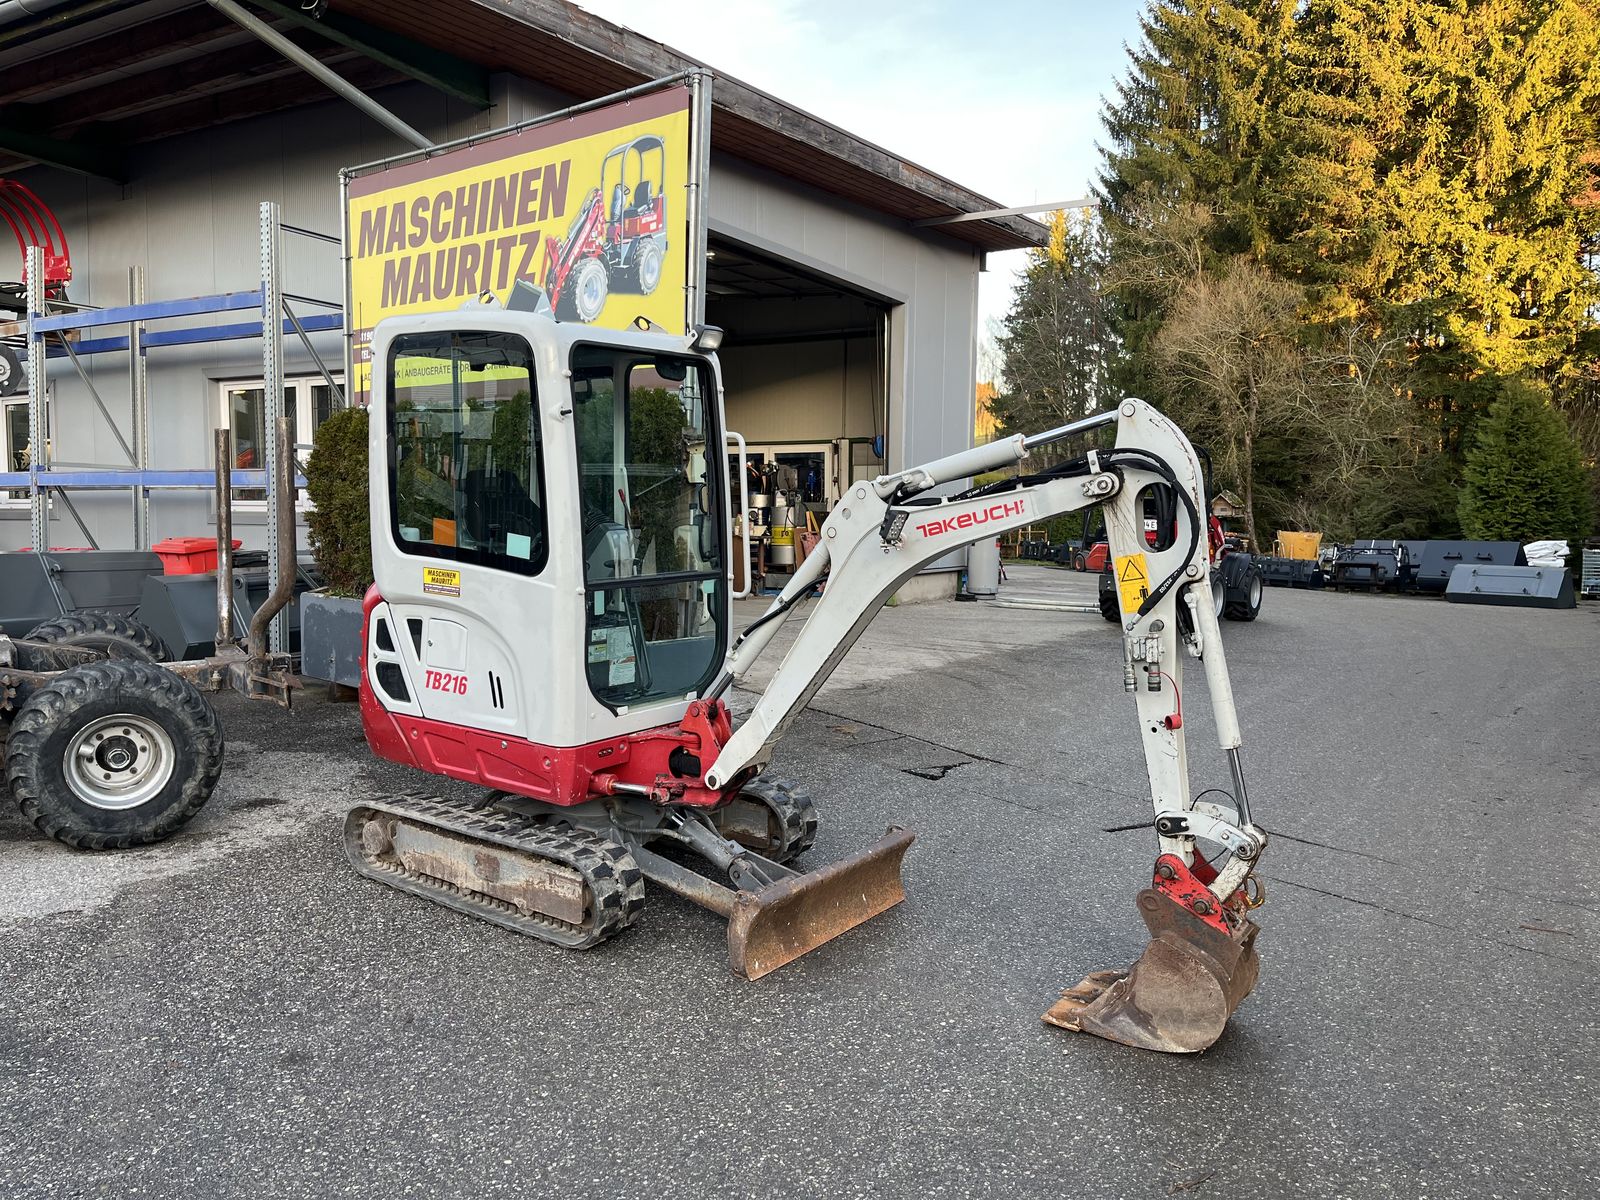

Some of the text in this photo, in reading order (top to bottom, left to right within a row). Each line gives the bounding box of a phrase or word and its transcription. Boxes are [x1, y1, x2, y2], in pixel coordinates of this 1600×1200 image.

[358, 160, 571, 259] MASCHINEN
[381, 230, 541, 309] MAURITZ
[405, 364, 451, 377] ANBAUGERÄTE
[916, 500, 1024, 538] TAKEUCHI
[427, 569, 457, 580] MASCHINEN
[431, 577, 453, 586] MAURITZ
[425, 670, 468, 695] TB216
